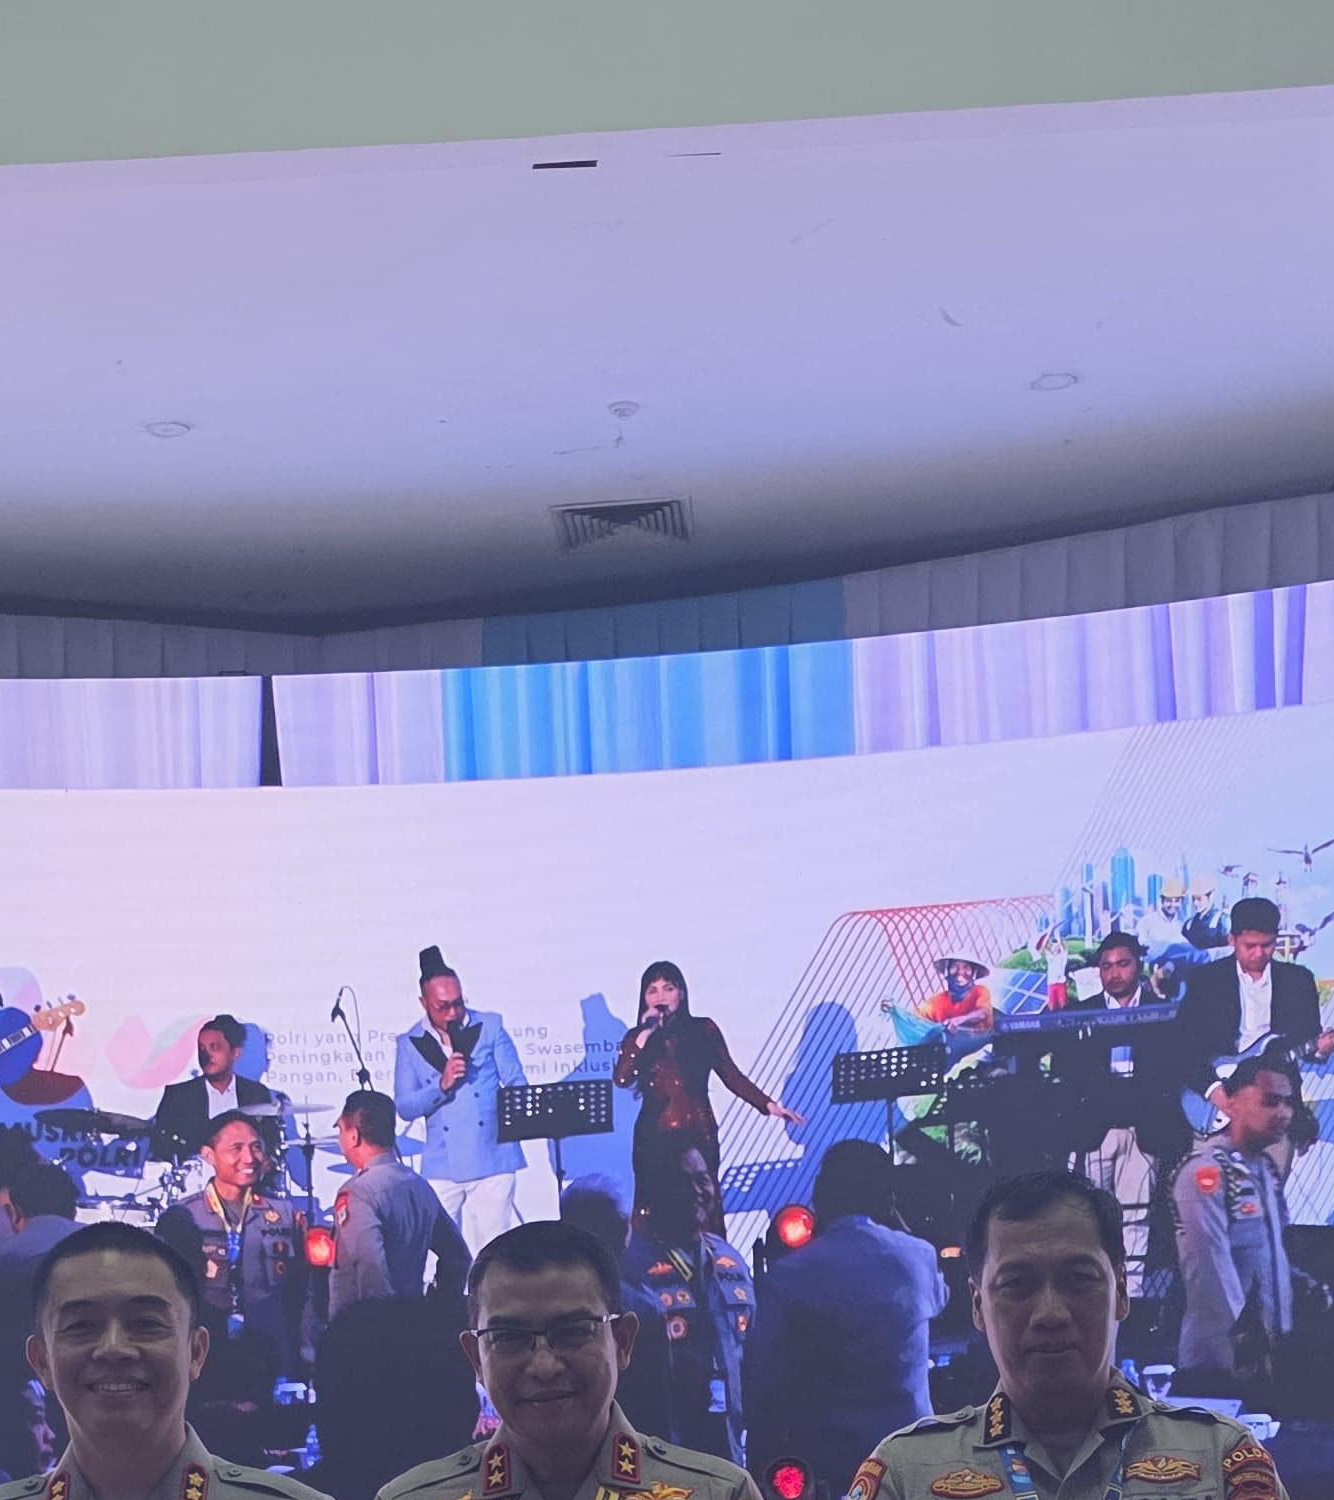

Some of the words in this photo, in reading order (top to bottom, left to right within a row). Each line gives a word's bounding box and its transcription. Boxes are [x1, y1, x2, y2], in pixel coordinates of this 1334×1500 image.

[266, 1030, 307, 1046] Polri
[513, 1025, 548, 1038] ung
[266, 1050, 386, 1066] Peningkaan
[59, 1146, 141, 1168] POLRI
